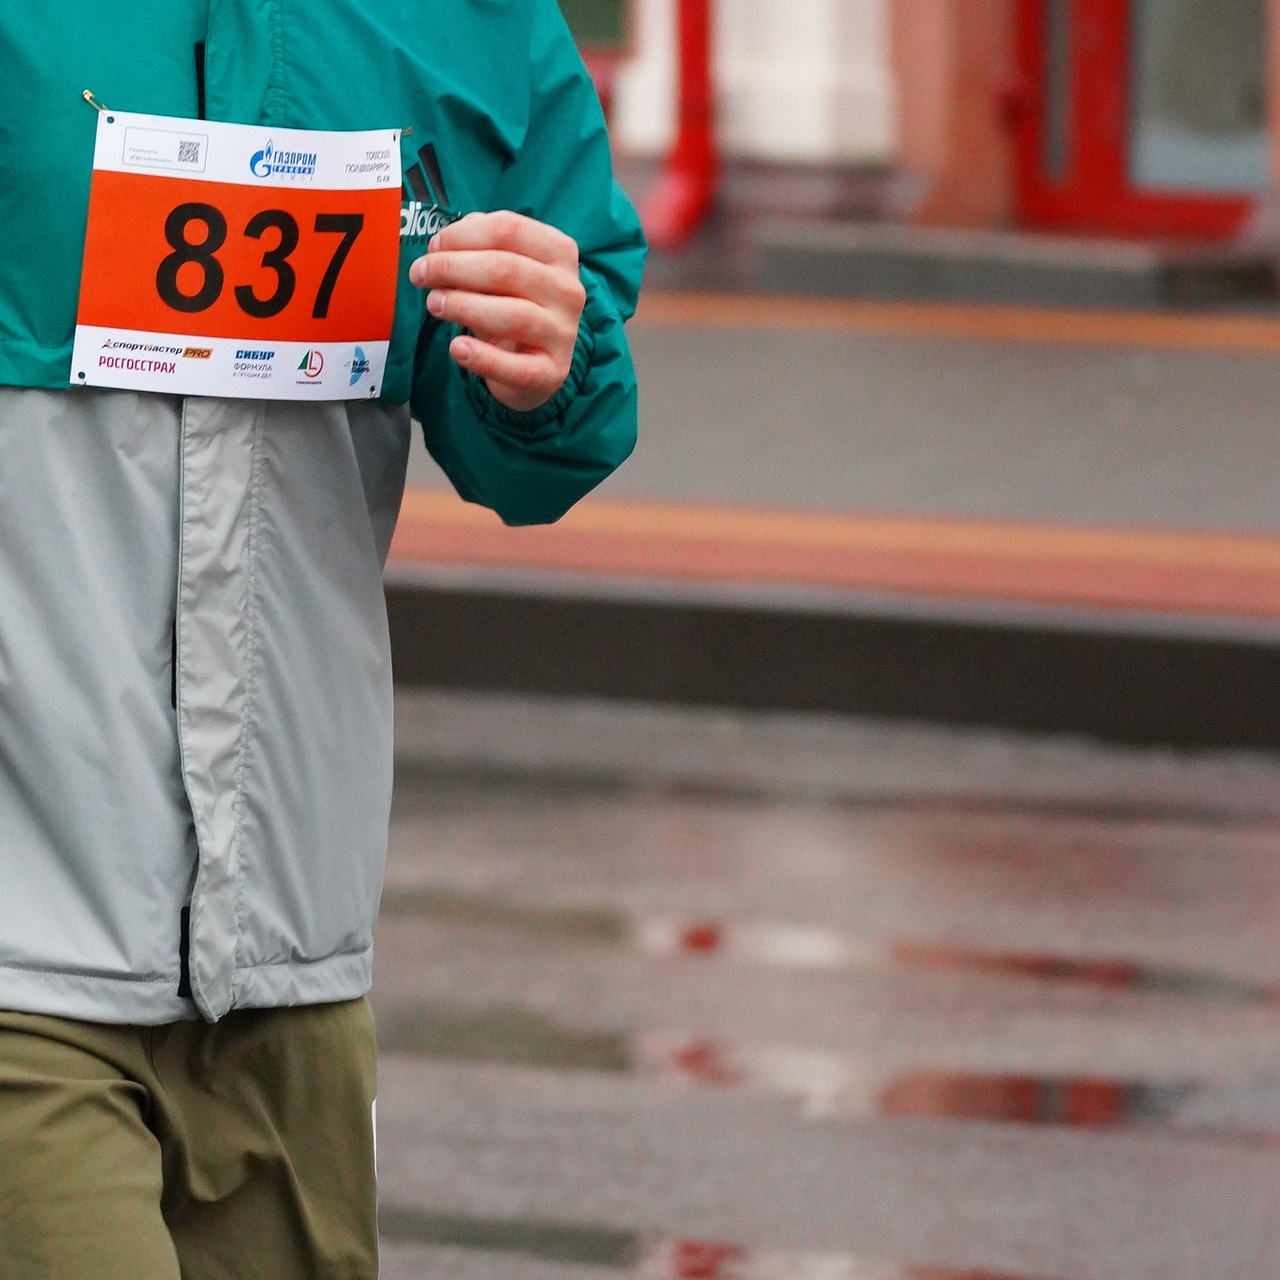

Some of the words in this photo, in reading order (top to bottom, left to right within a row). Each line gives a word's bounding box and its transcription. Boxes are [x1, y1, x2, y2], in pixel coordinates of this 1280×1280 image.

[273, 151, 317, 166] ГАЗПРОМ
[156, 202, 364, 319] 837
[183, 347, 211, 359] PRO
[235, 350, 275, 360] СИБУР
[99, 355, 176, 373] РОСГОССТРАХ
